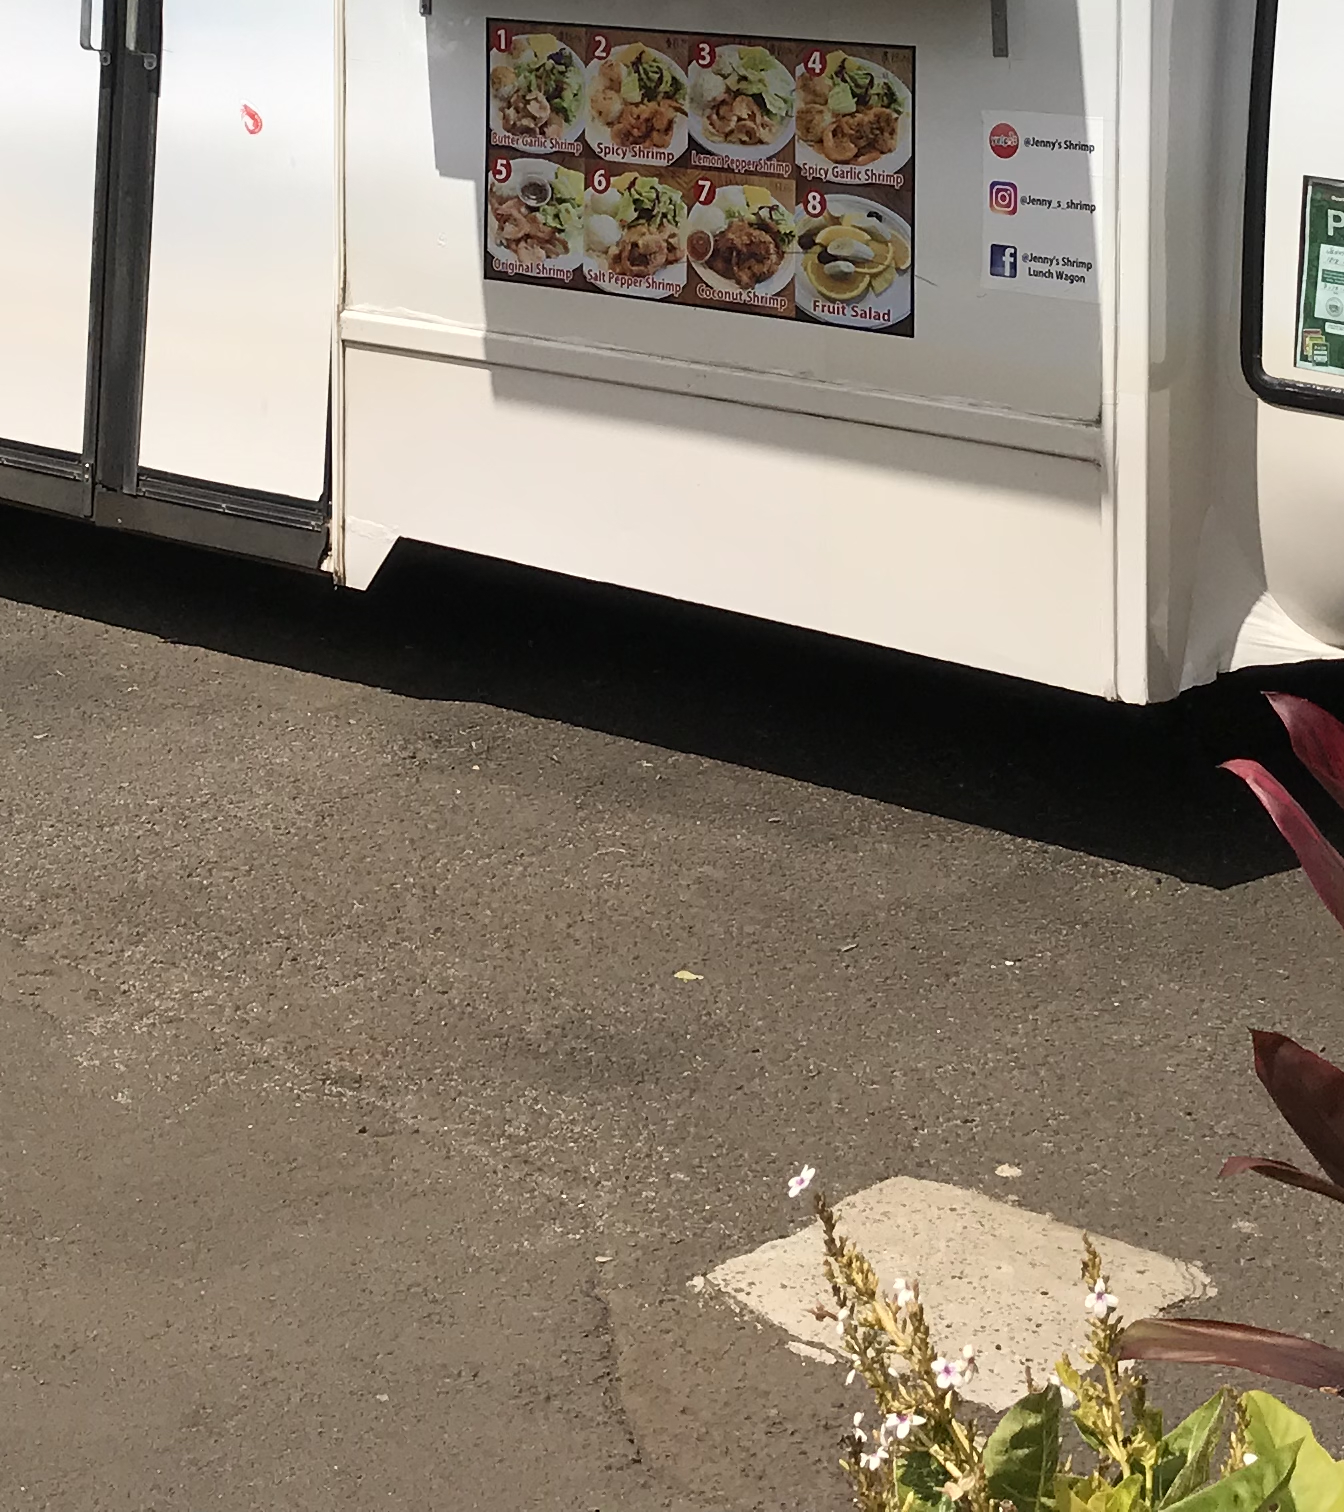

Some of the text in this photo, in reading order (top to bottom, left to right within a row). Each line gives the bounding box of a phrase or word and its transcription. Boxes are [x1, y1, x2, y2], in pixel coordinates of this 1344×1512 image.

[497, 29, 506, 50] 1
[594, 36, 606, 57] 2
[697, 43, 711, 66] 3
[807, 51, 822, 74] 4
[491, 131, 584, 156] Butter Garlic Shrimp
[597, 142, 676, 164] Spicy Shrimp
[1023, 137, 1095, 154] @Jenny's Shrimp
[495, 159, 507, 180] 5
[690, 150, 792, 175] Lemon Pepper Shrimp
[593, 169, 606, 190] 6
[800, 162, 905, 189] Spicy Garlic Shrimp
[697, 179, 711, 202] 7
[807, 191, 822, 214] 8
[1020, 195, 1096, 213] @Jenny_s_shrimp
[492, 257, 573, 282] Original Shrimp
[1021, 252, 1093, 270] @Jenny's Shrimp
[586, 268, 682, 296] Salt Pepper Shrimp
[1028, 267, 1086, 284] Lunch Wagon
[696, 284, 788, 310] Coconut Shrimp
[812, 299, 891, 323] Fruit Salad
